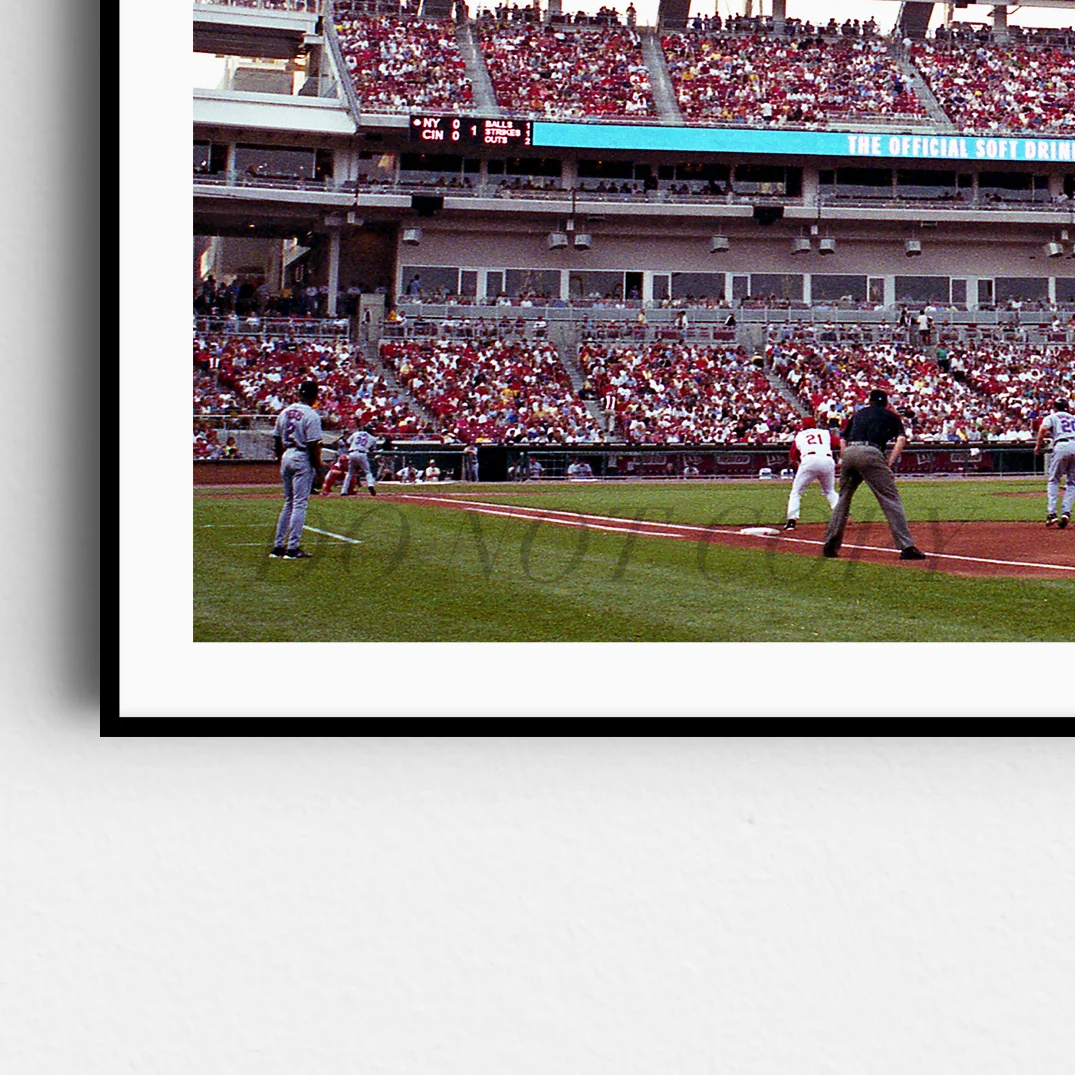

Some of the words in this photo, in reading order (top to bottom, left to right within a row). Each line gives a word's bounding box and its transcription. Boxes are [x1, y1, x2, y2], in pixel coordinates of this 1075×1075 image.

[423, 118, 440, 128] NY
[452, 119, 460, 130] 0
[485, 120, 513, 128] BALLS
[422, 130, 444, 140] CIN
[452, 131, 460, 140] 0
[471, 126, 476, 136] 1
[484, 128, 521, 136] STRIKES
[484, 136, 508, 144] OUTS
[848, 135, 881, 155] THE
[889, 136, 968, 158] OFFICIAL
[976, 139, 1019, 159] SOFT
[286, 422, 296, 442] 2
[806, 434, 822, 444] 21
